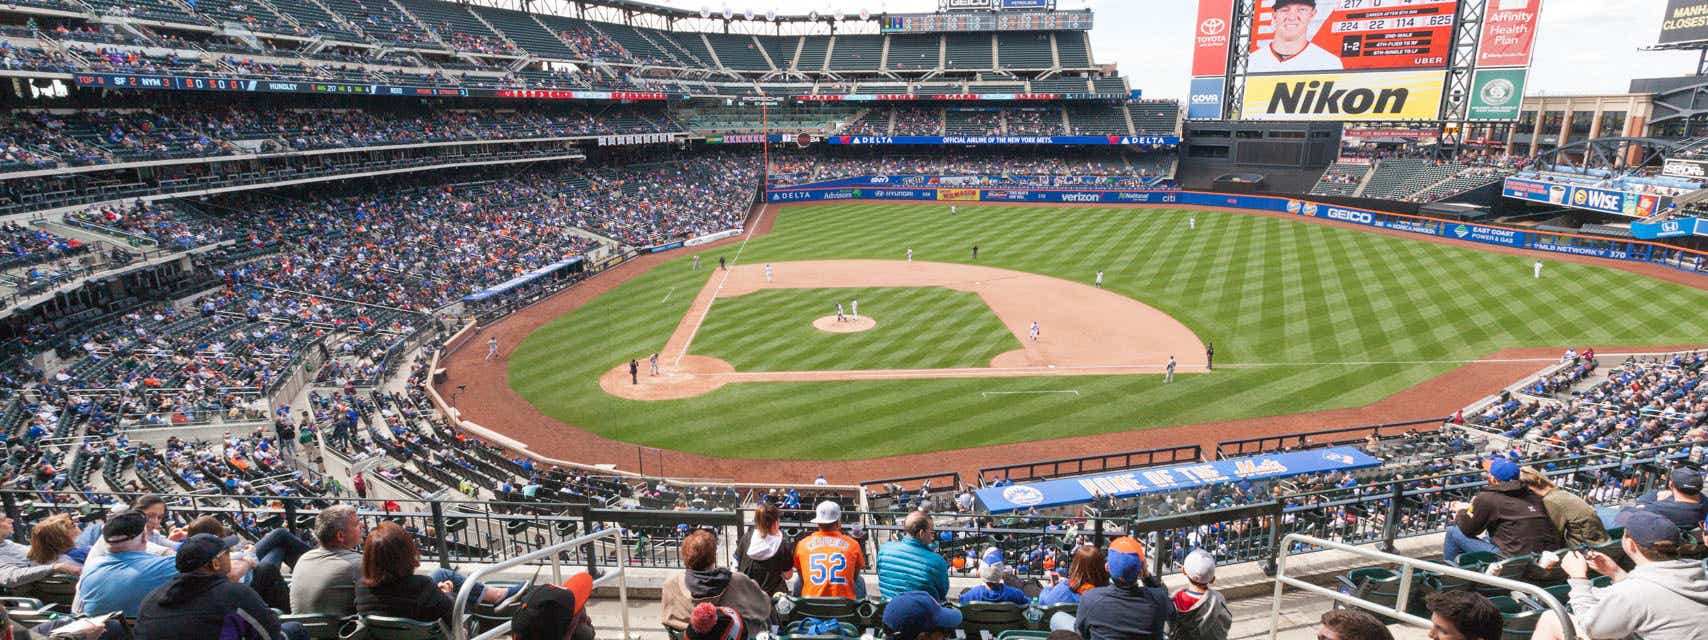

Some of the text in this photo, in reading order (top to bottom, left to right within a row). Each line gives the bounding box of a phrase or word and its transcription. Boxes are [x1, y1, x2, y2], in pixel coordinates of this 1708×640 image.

[1673, 4, 1708, 18] MANH
[1489, 12, 1534, 22] Affinity
[1338, 16, 1452, 32] .224 22 114 .625
[1490, 24, 1527, 34] Health
[1496, 36, 1518, 46] Plan
[1344, 42, 1360, 51] 1-2
[130, 78, 136, 86] 2
[142, 78, 160, 86] NYM
[163, 78, 170, 87] 3
[1192, 94, 1218, 104] GOYA
[1266, 80, 1409, 114] Nikon
[1062, 193, 1098, 202] verizon
[1162, 194, 1176, 202] citi
[1588, 190, 1619, 210] WISE
[1328, 208, 1372, 224] GEICO
[1492, 229, 1515, 237] COAST
[1078, 474, 1149, 497] HOME
[1144, 470, 1178, 488] OF
[1176, 464, 1229, 486] THE
[809, 552, 846, 585] 52
